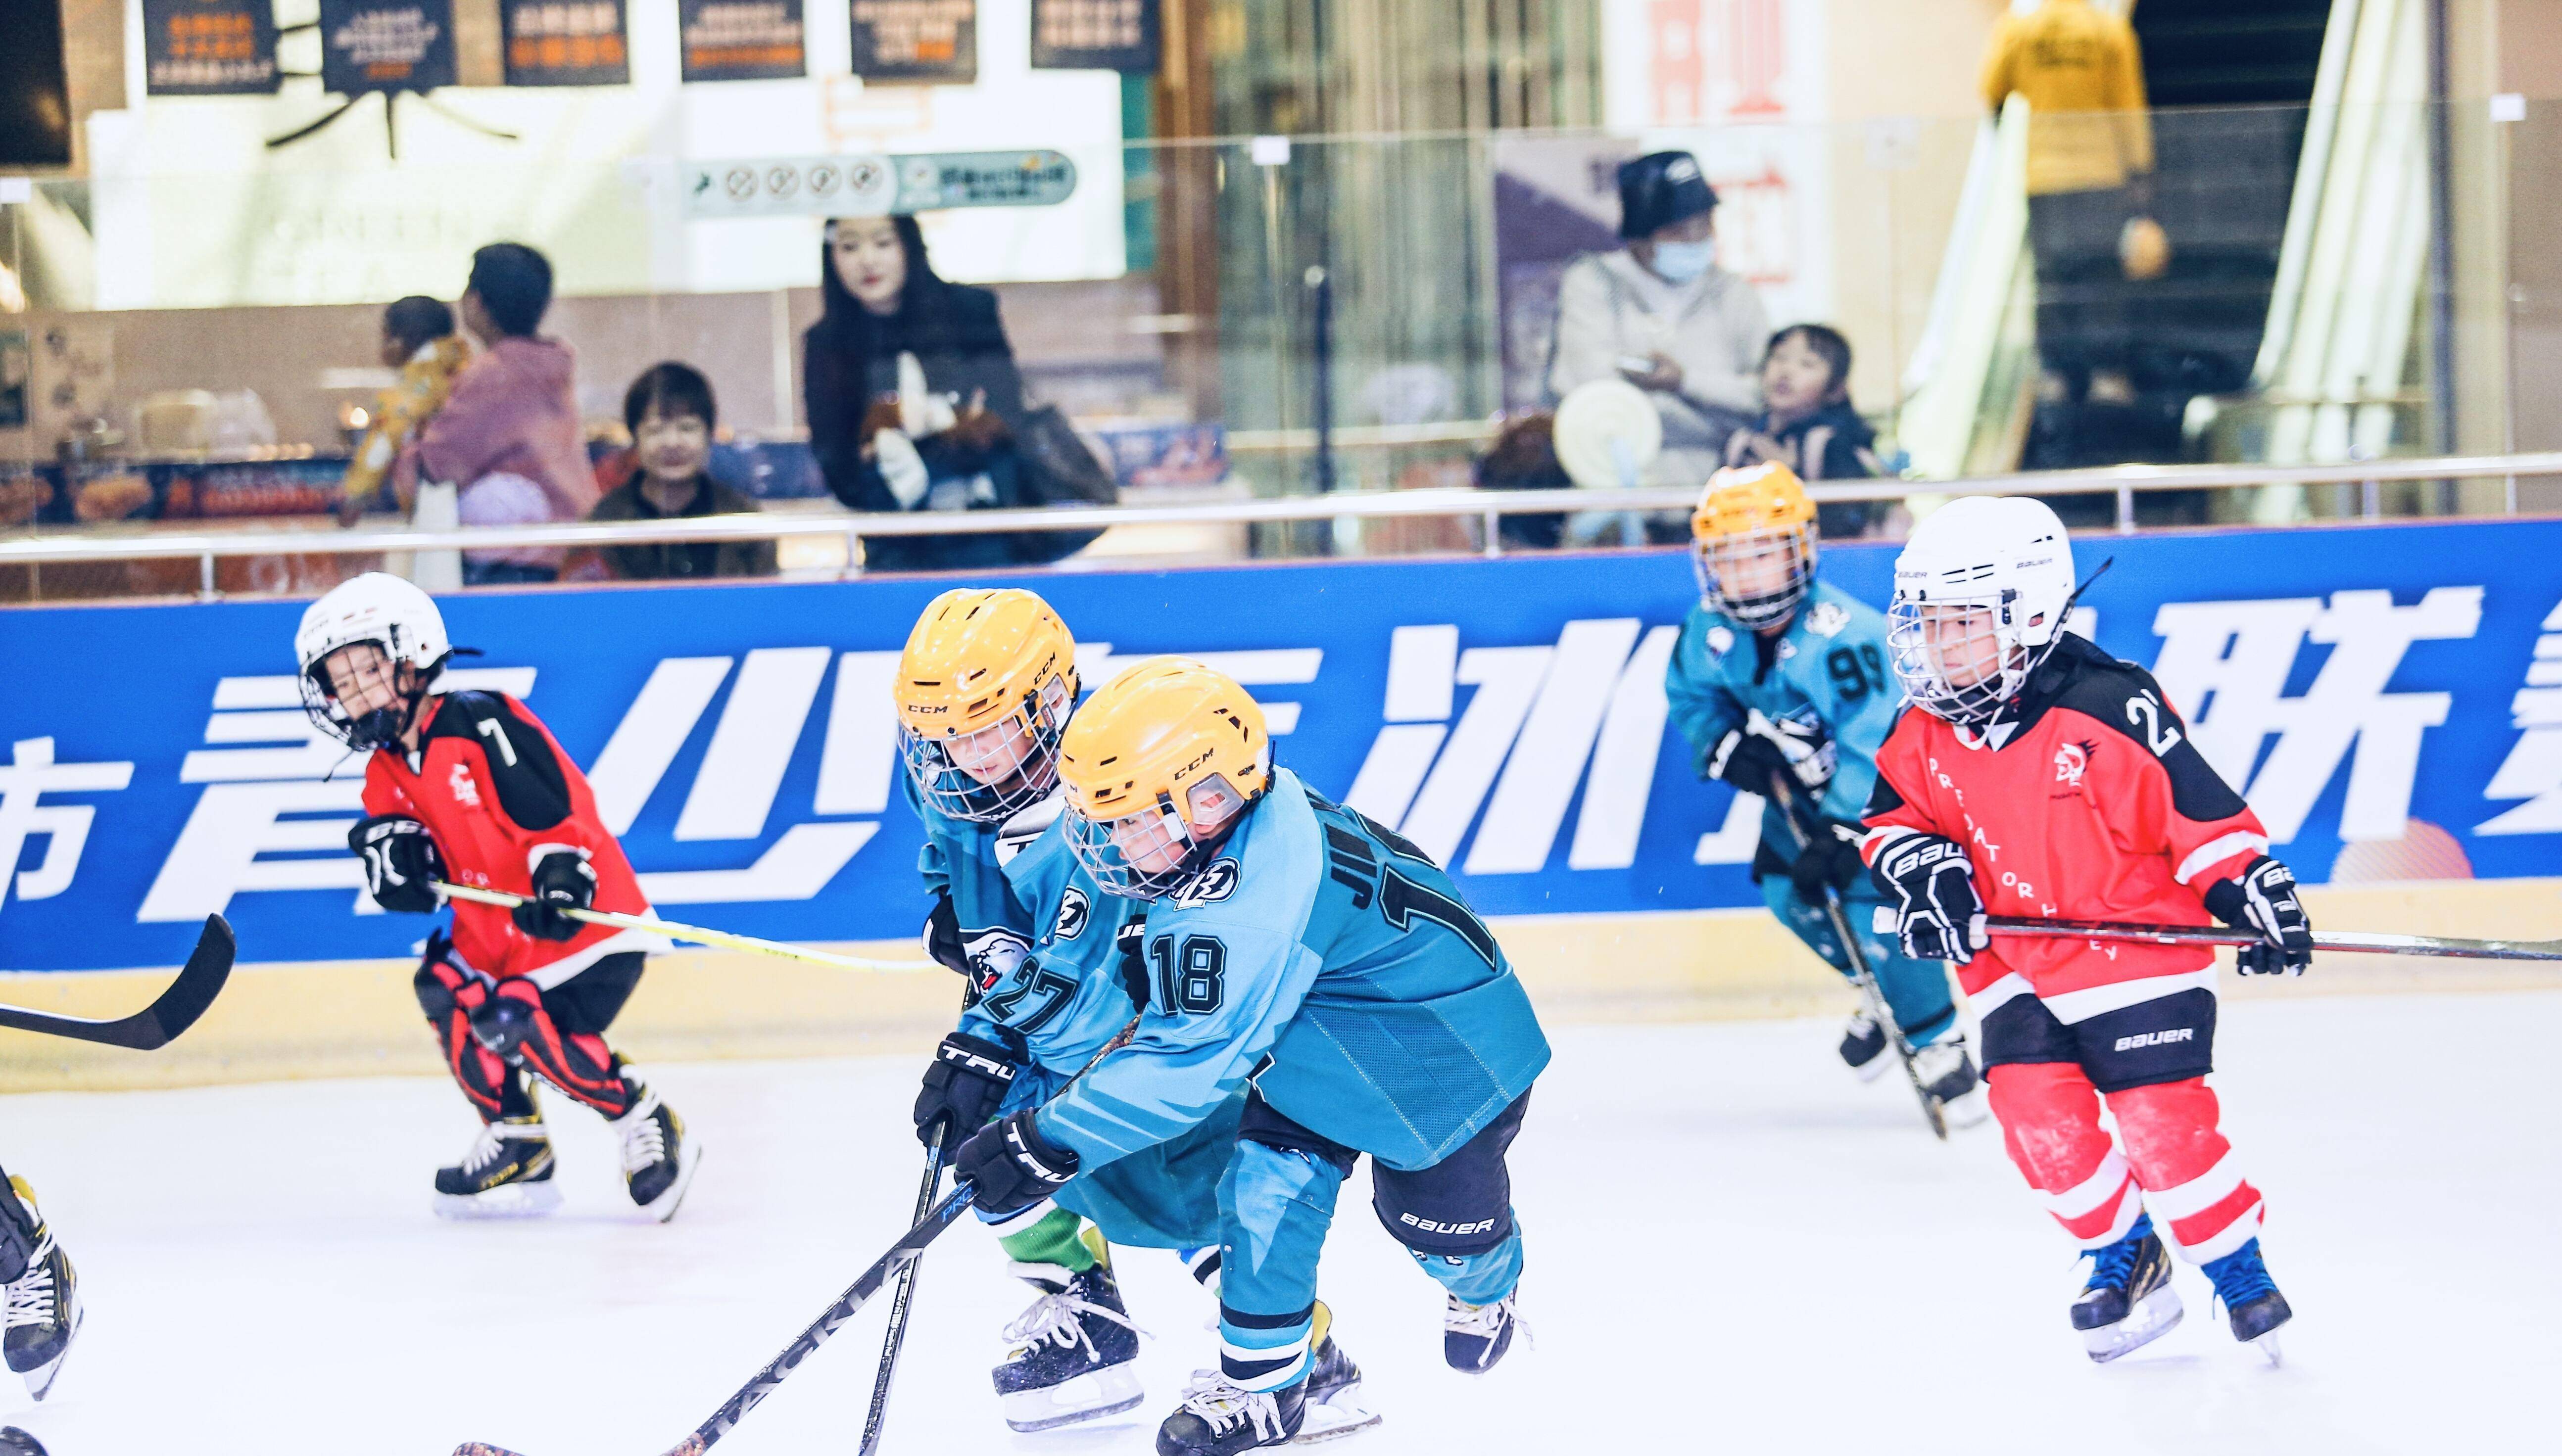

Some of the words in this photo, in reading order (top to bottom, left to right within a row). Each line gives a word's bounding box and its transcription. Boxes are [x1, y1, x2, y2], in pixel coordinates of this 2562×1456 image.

[1033, 651, 1056, 685] CCM
[1827, 644, 1886, 702] 99
[908, 704, 948, 714] CCM
[2126, 688, 2182, 758] 2
[477, 717, 518, 767] 7
[1174, 747, 1214, 781] CCM
[980, 955, 1080, 1035] 27
[1150, 933, 1229, 1019] 18
[2114, 1028, 2193, 1052] BAUER
[942, 1044, 1015, 1080] TRU
[1007, 1121, 1079, 1183] TRU
[1400, 1212, 1496, 1235] BAUER
